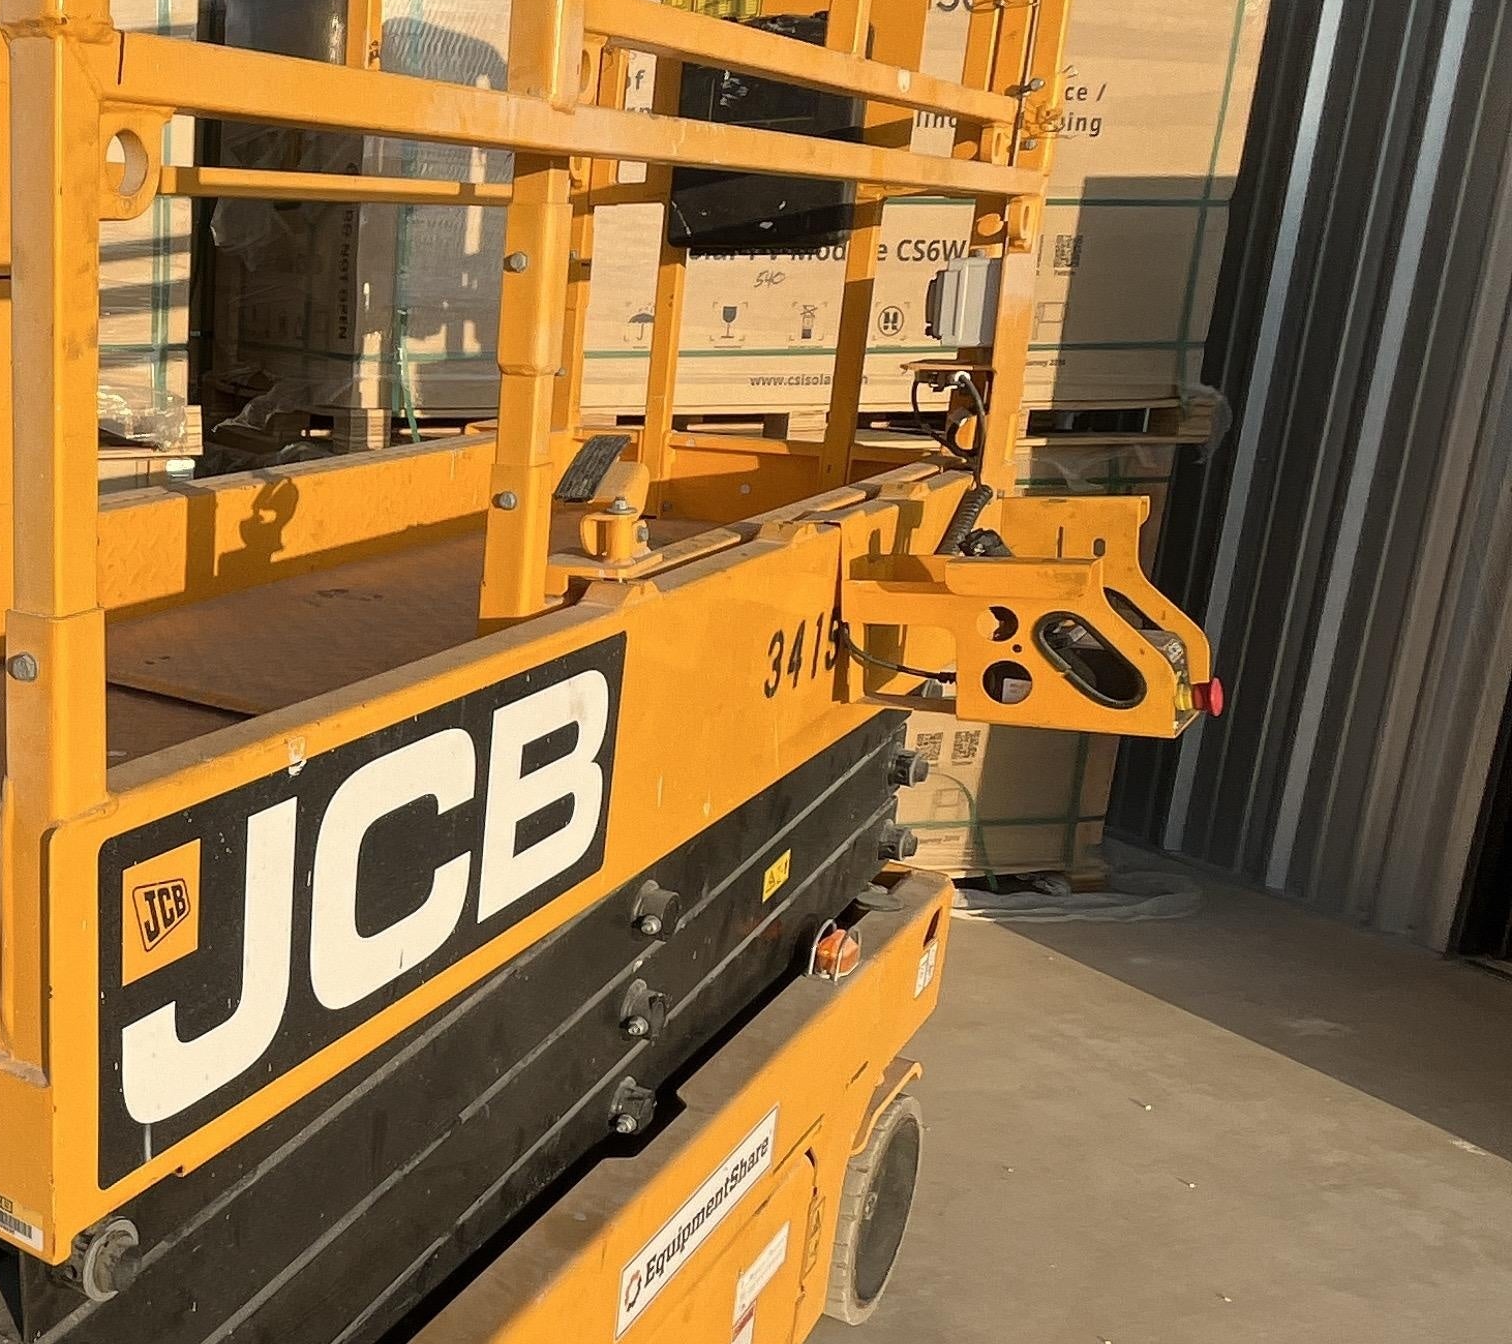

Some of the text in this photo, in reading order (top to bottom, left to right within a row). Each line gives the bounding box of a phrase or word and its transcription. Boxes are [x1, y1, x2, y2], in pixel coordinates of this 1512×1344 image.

[896, 239, 967, 262] CS6W
[121, 668, 610, 1125] JCB
[143, 883, 187, 944] JCB
[643, 1136, 770, 1289] EquipmentShare
